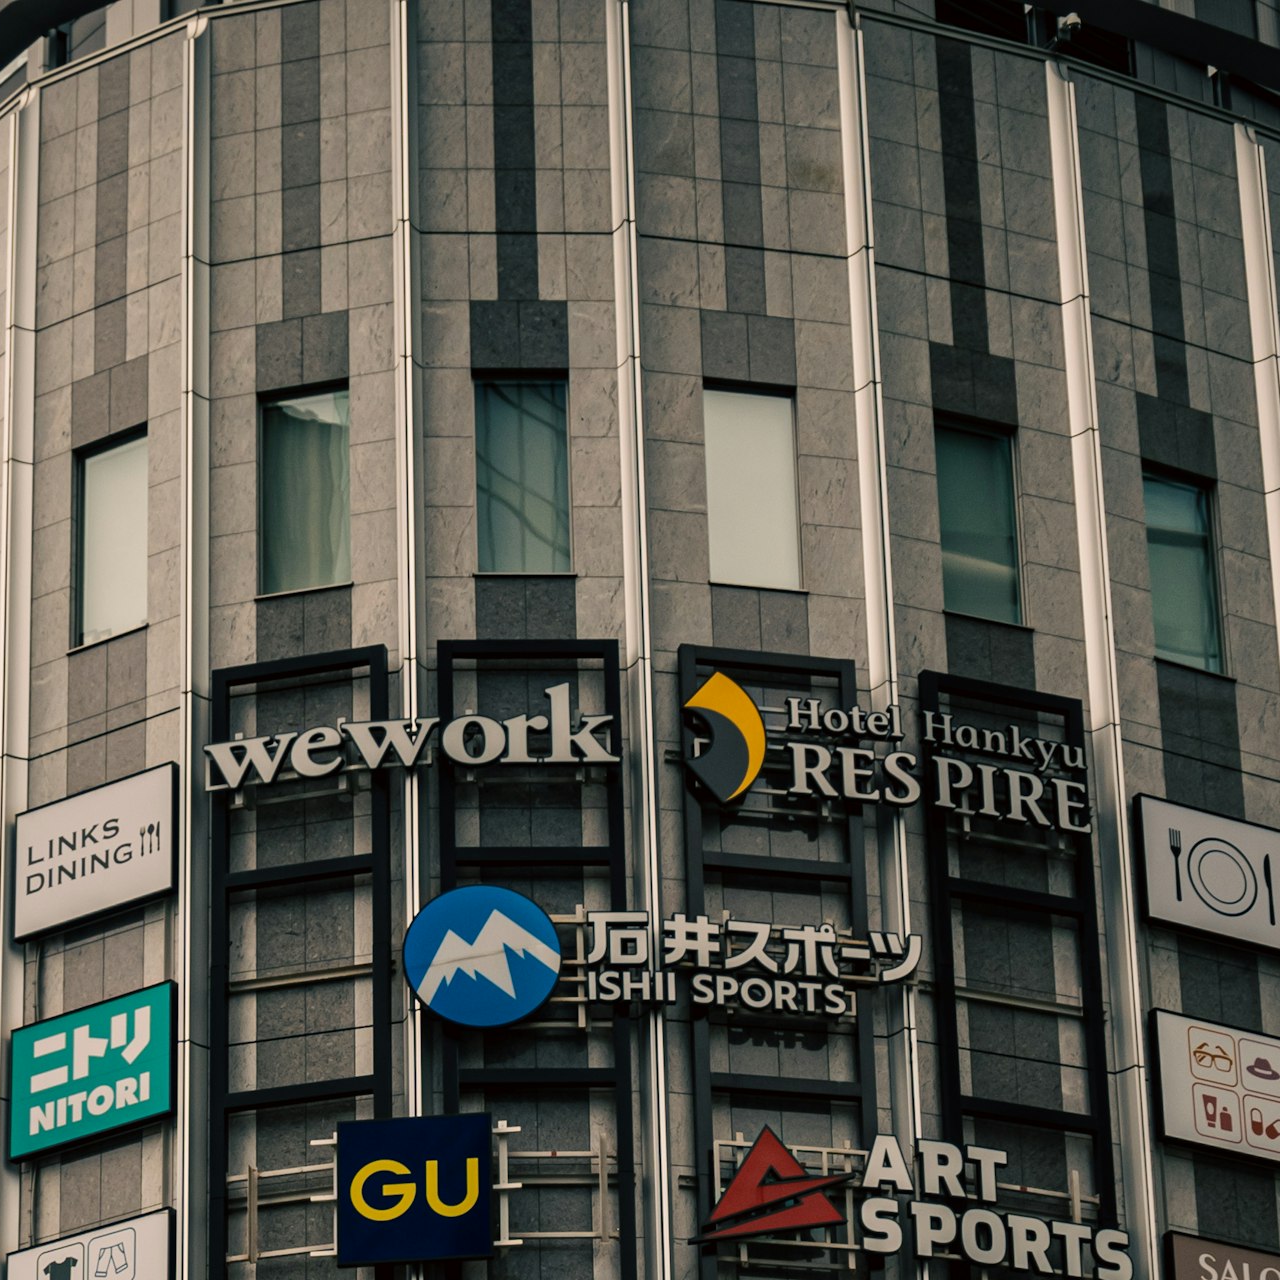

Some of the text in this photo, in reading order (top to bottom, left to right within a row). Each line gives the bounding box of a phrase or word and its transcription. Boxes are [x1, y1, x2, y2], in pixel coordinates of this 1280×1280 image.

[202, 682, 620, 789] wework
[786, 697, 1087, 770] Hotel Hankyu
[787, 742, 1092, 834] RESPIRE
[25, 843, 133, 895] DINING
[27, 818, 120, 866] LINKS
[586, 910, 922, 981] 石井スポーツ
[588, 970, 846, 1015] ISHII SPORTS
[30, 1005, 151, 1094] ニトリ
[29, 1071, 151, 1136] NITORI
[350, 1157, 479, 1221] GU
[862, 1134, 1008, 1202] ART
